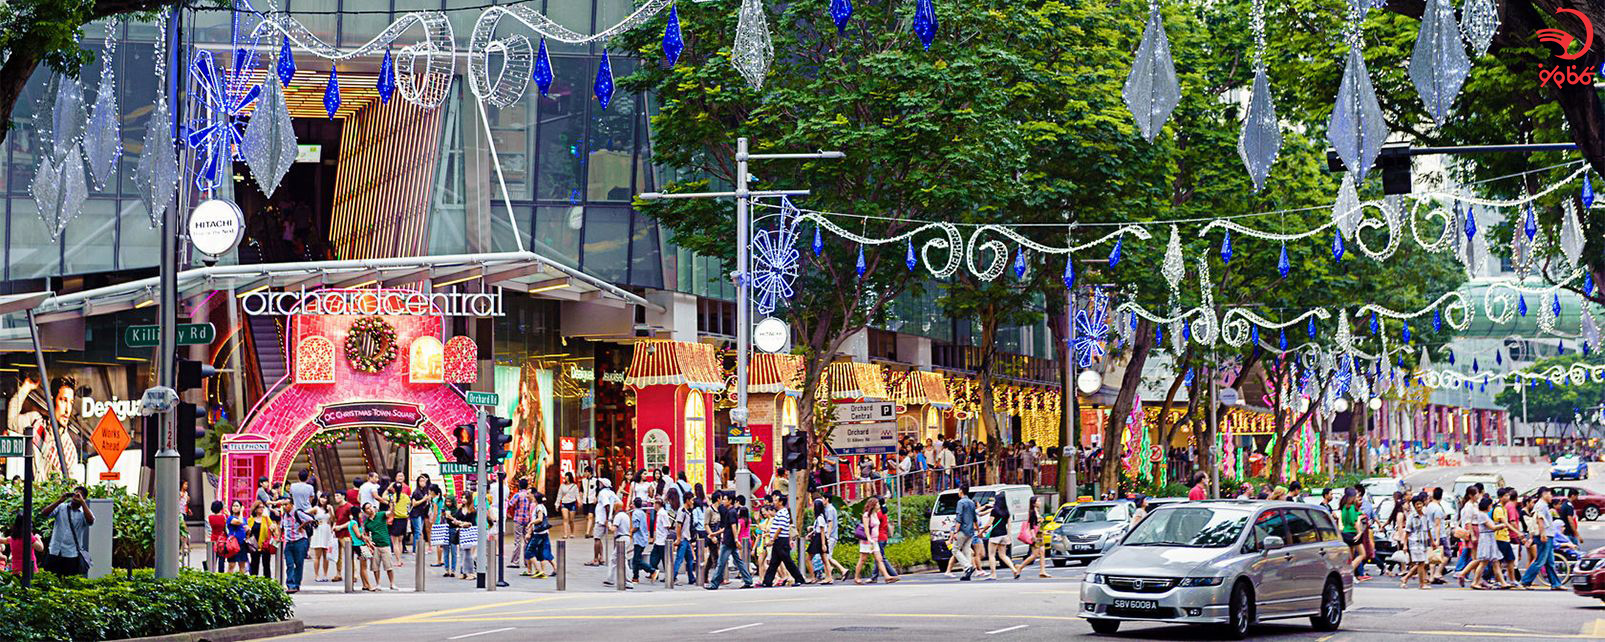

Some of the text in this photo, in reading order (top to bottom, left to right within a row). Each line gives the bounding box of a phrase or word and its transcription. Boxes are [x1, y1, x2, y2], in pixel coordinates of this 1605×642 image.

[195, 219, 232, 229] HITACHI
[242, 283, 506, 316] orchardcentral
[132, 326, 206, 342] Killiy Rd
[469, 393, 498, 405] Orchard Rd
[82, 396, 143, 422] Desigua
[324, 412, 335, 421] OC
[392, 409, 416, 420] SQUARE
[101, 428, 120, 439] Works
[0, 442, 23, 454] RD RD
[101, 441, 120, 451] Ahead
